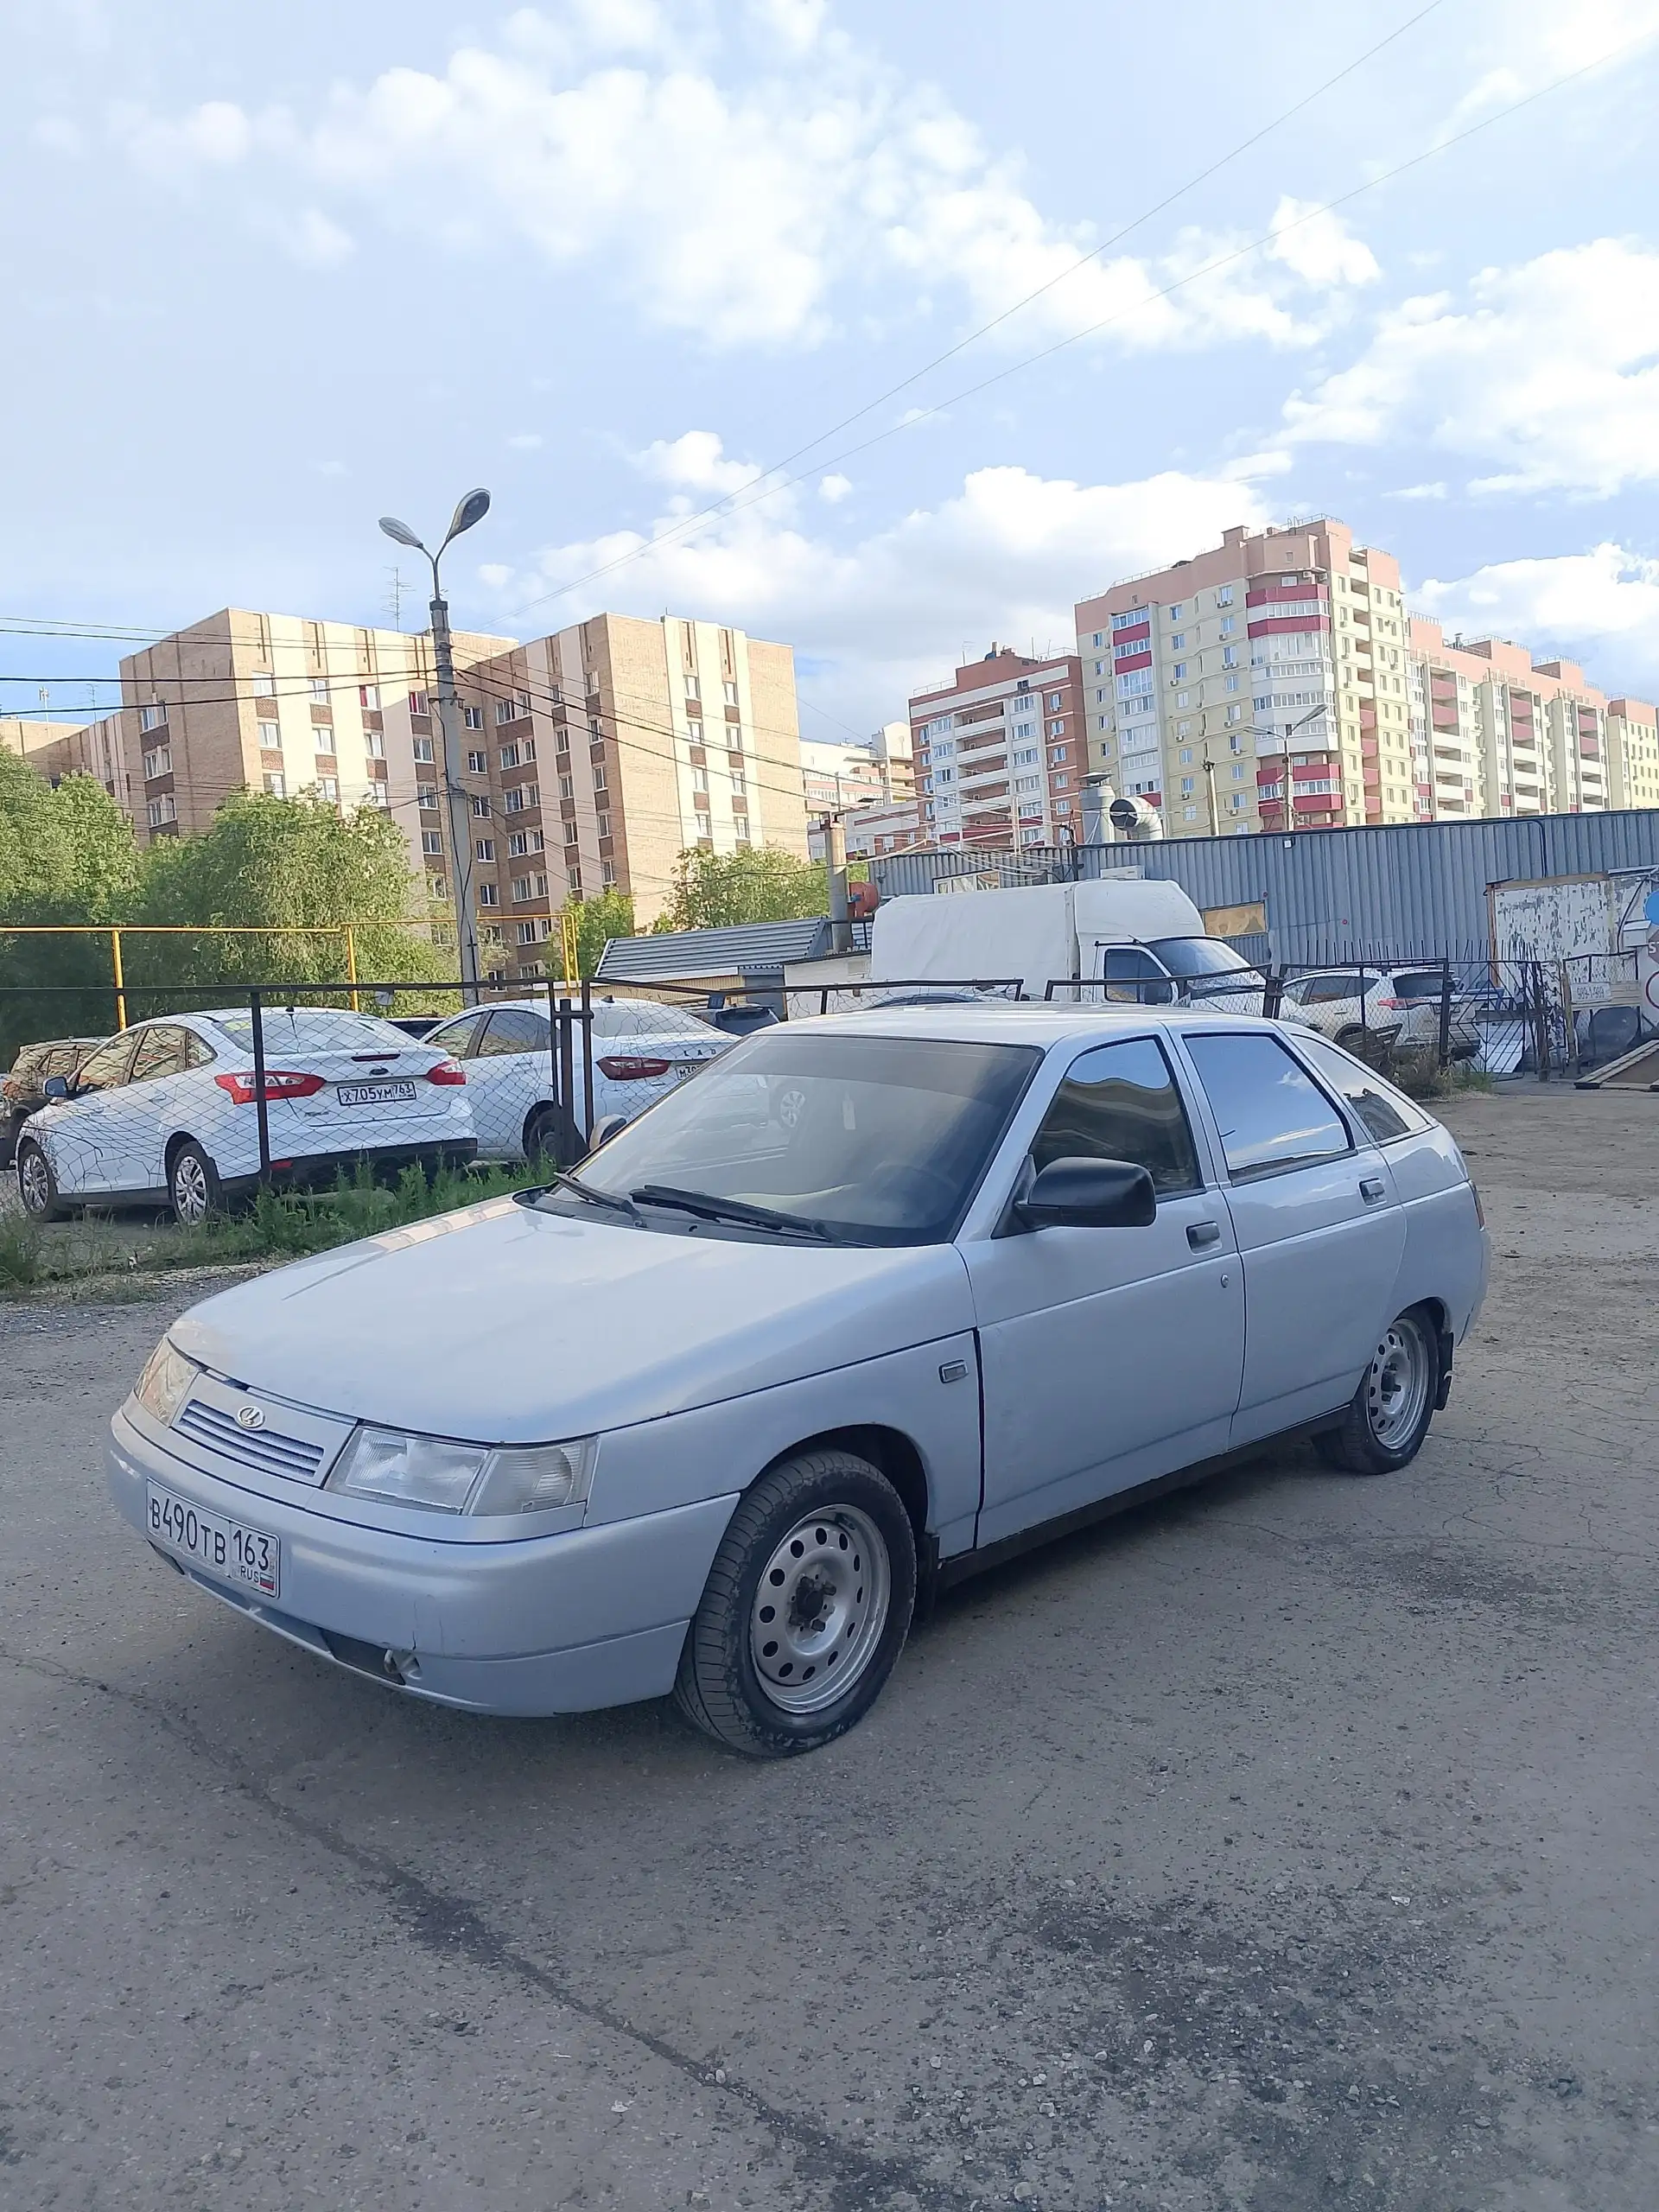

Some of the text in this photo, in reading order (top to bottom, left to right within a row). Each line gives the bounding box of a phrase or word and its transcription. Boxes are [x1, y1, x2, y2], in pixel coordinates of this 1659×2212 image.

[344, 1084, 410, 1102] Х705УМ 763
[151, 1496, 269, 1571] В490ТВ 163
[240, 1565, 259, 1583] RUS
